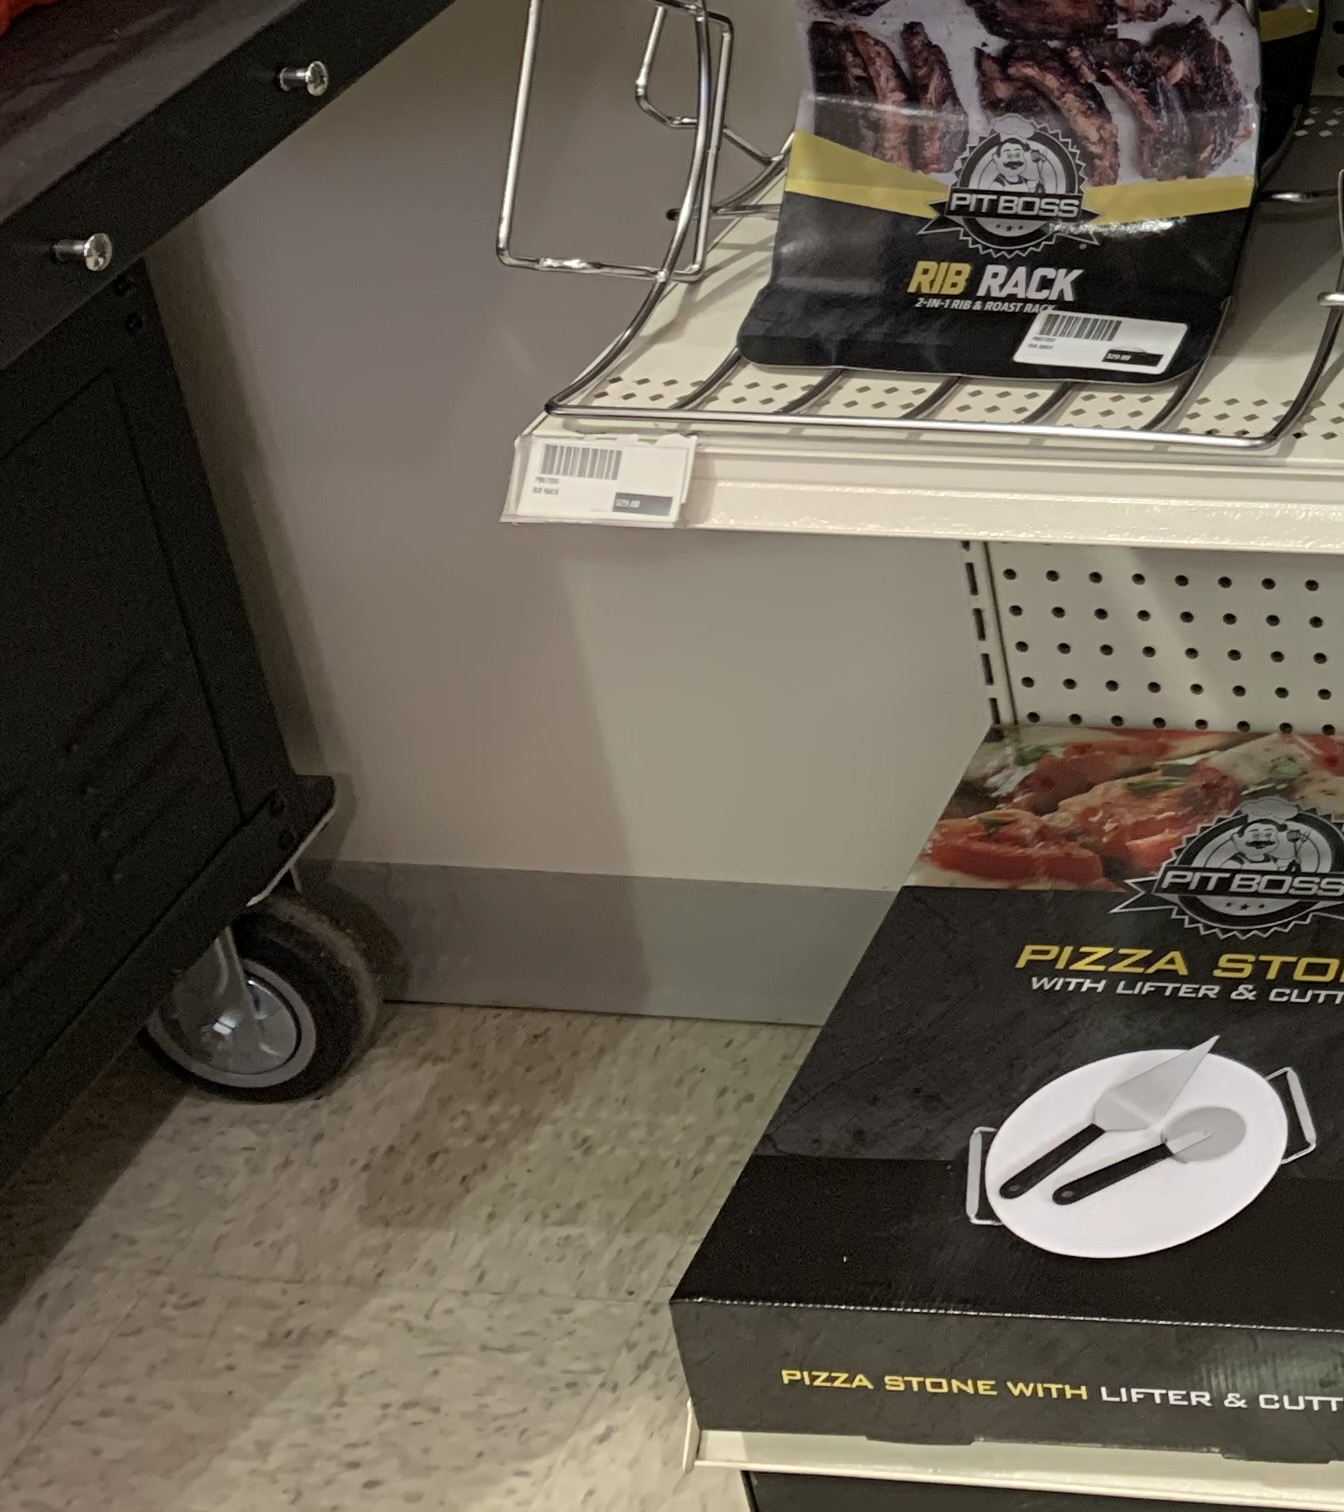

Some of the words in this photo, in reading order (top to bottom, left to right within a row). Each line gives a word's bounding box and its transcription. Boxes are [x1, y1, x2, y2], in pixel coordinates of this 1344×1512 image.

[907, 260, 972, 296] RIB
[976, 264, 1084, 302] RACK
[1015, 944, 1188, 976] PIZZA
[1031, 976, 1106, 994] WITH
[1116, 980, 1219, 1000] LIFTER
[1230, 984, 1256, 1001] &
